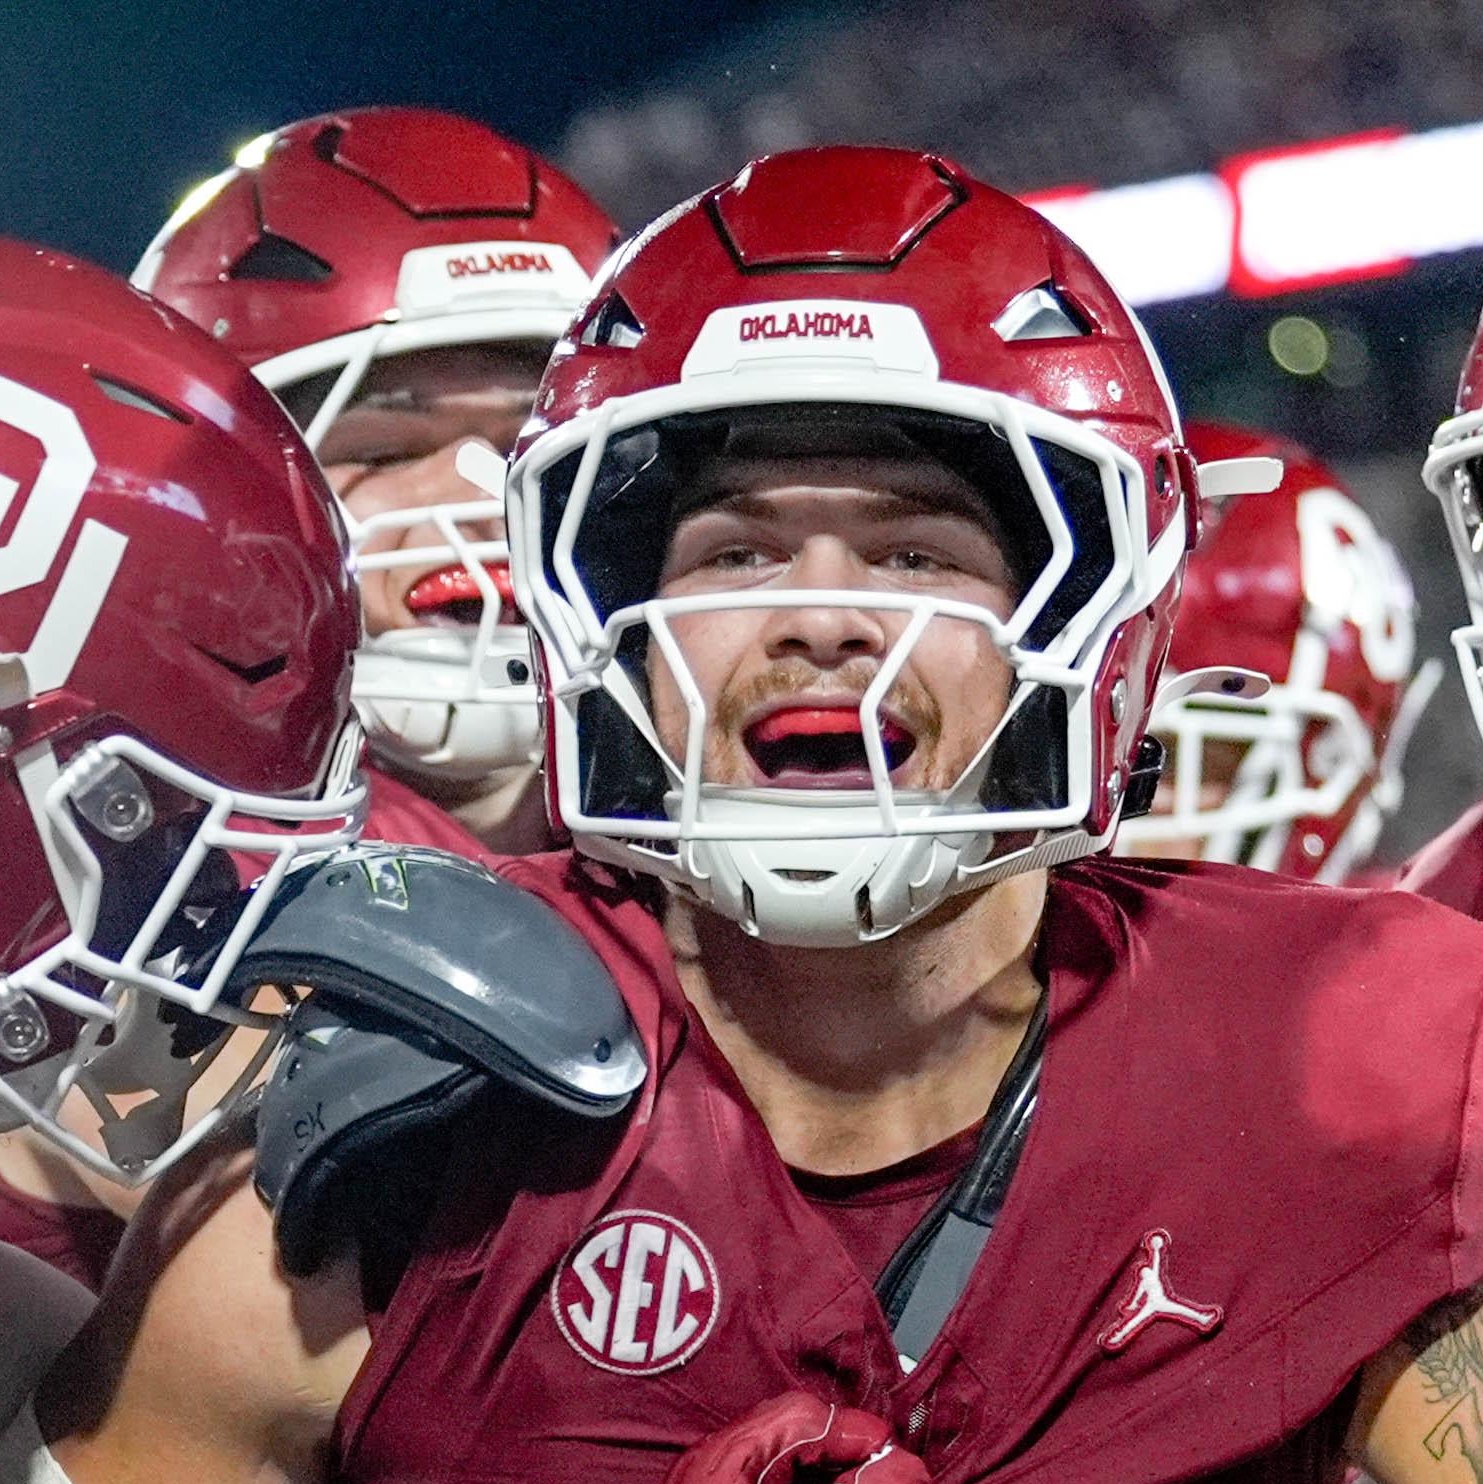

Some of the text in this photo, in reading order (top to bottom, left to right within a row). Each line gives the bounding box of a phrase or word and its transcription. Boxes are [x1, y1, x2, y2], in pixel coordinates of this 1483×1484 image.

[446, 252, 553, 279] OKLAHOMA
[739, 312, 874, 342] OKLAHOMA
[566, 1222, 706, 1364] SEC
